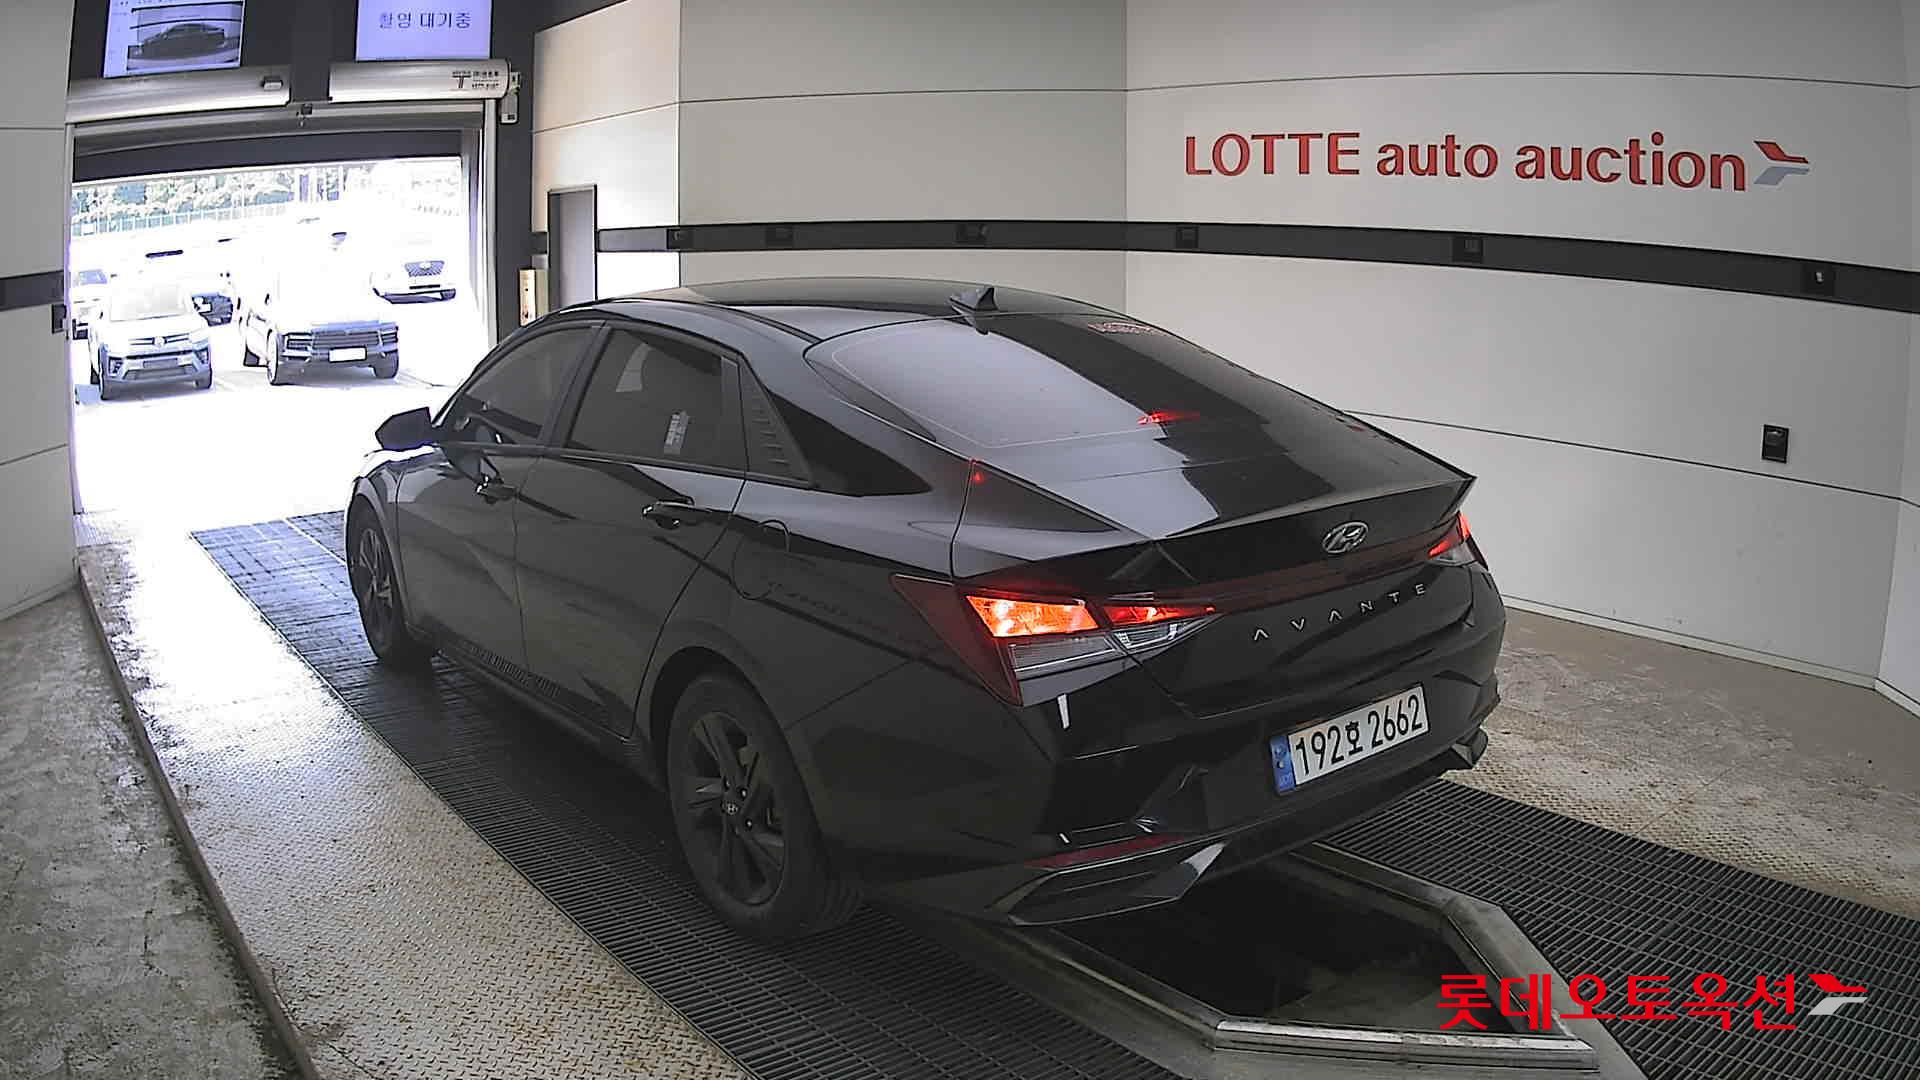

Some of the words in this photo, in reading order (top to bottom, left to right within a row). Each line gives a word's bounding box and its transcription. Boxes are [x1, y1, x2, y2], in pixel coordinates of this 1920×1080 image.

[420, 12, 472, 29] 대기중
[1185, 132, 1360, 177] LOTTE
[1376, 134, 1499, 178] auto
[1515, 131, 1747, 192] auction
[1253, 583, 1426, 641] AVANTE
[1295, 721, 1363, 776] 192호
[1368, 694, 1423, 748] 2662
